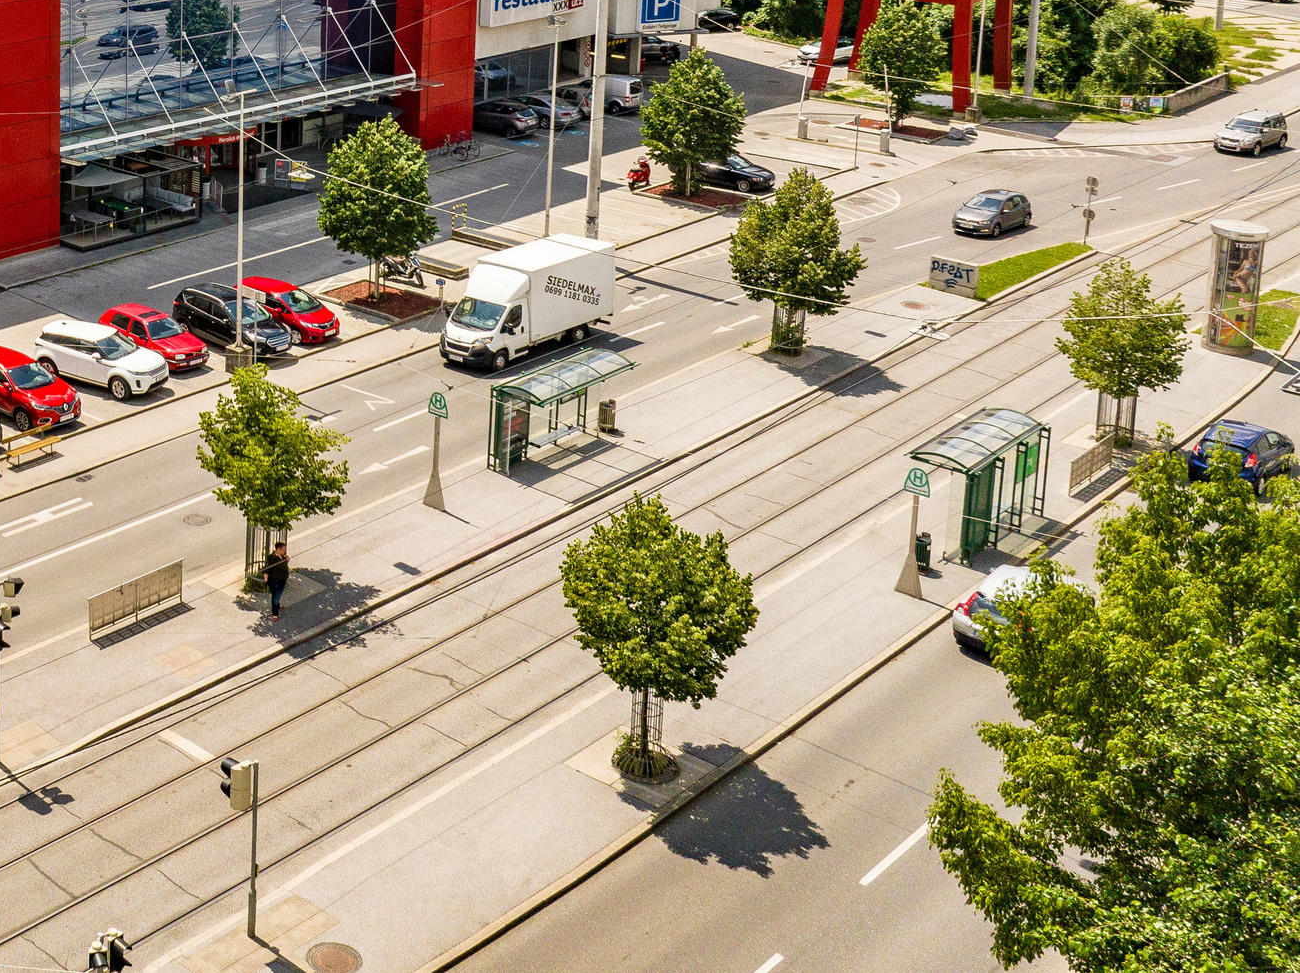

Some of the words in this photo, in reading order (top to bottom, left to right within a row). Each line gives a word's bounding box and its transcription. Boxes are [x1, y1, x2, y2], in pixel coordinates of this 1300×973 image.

[544, 285, 563, 296] 0699
[563, 290, 580, 301] 1181
[582, 295, 600, 306] 0335
[913, 470, 923, 484] H
